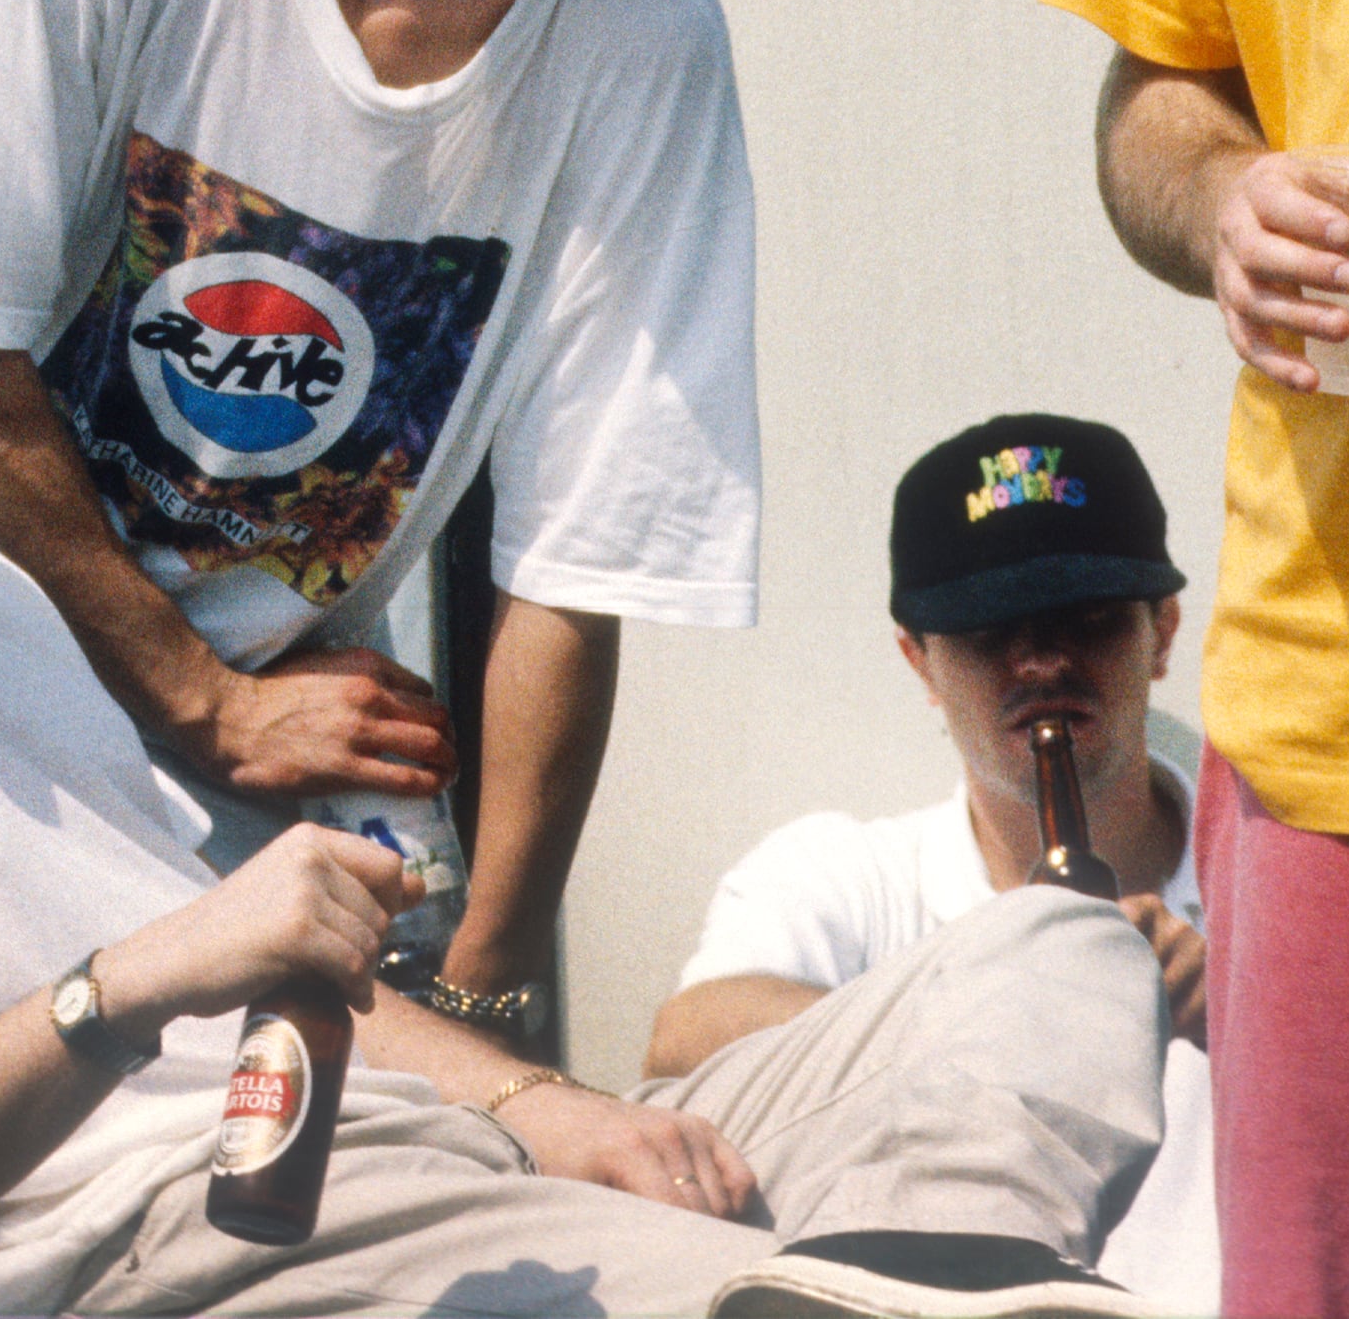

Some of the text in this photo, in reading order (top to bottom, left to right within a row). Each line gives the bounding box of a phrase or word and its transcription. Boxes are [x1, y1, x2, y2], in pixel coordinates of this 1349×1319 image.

[978, 444, 1064, 489] HAPPY
[965, 469, 1088, 523] MONDAYS
[230, 1075, 284, 1095] TELLA
